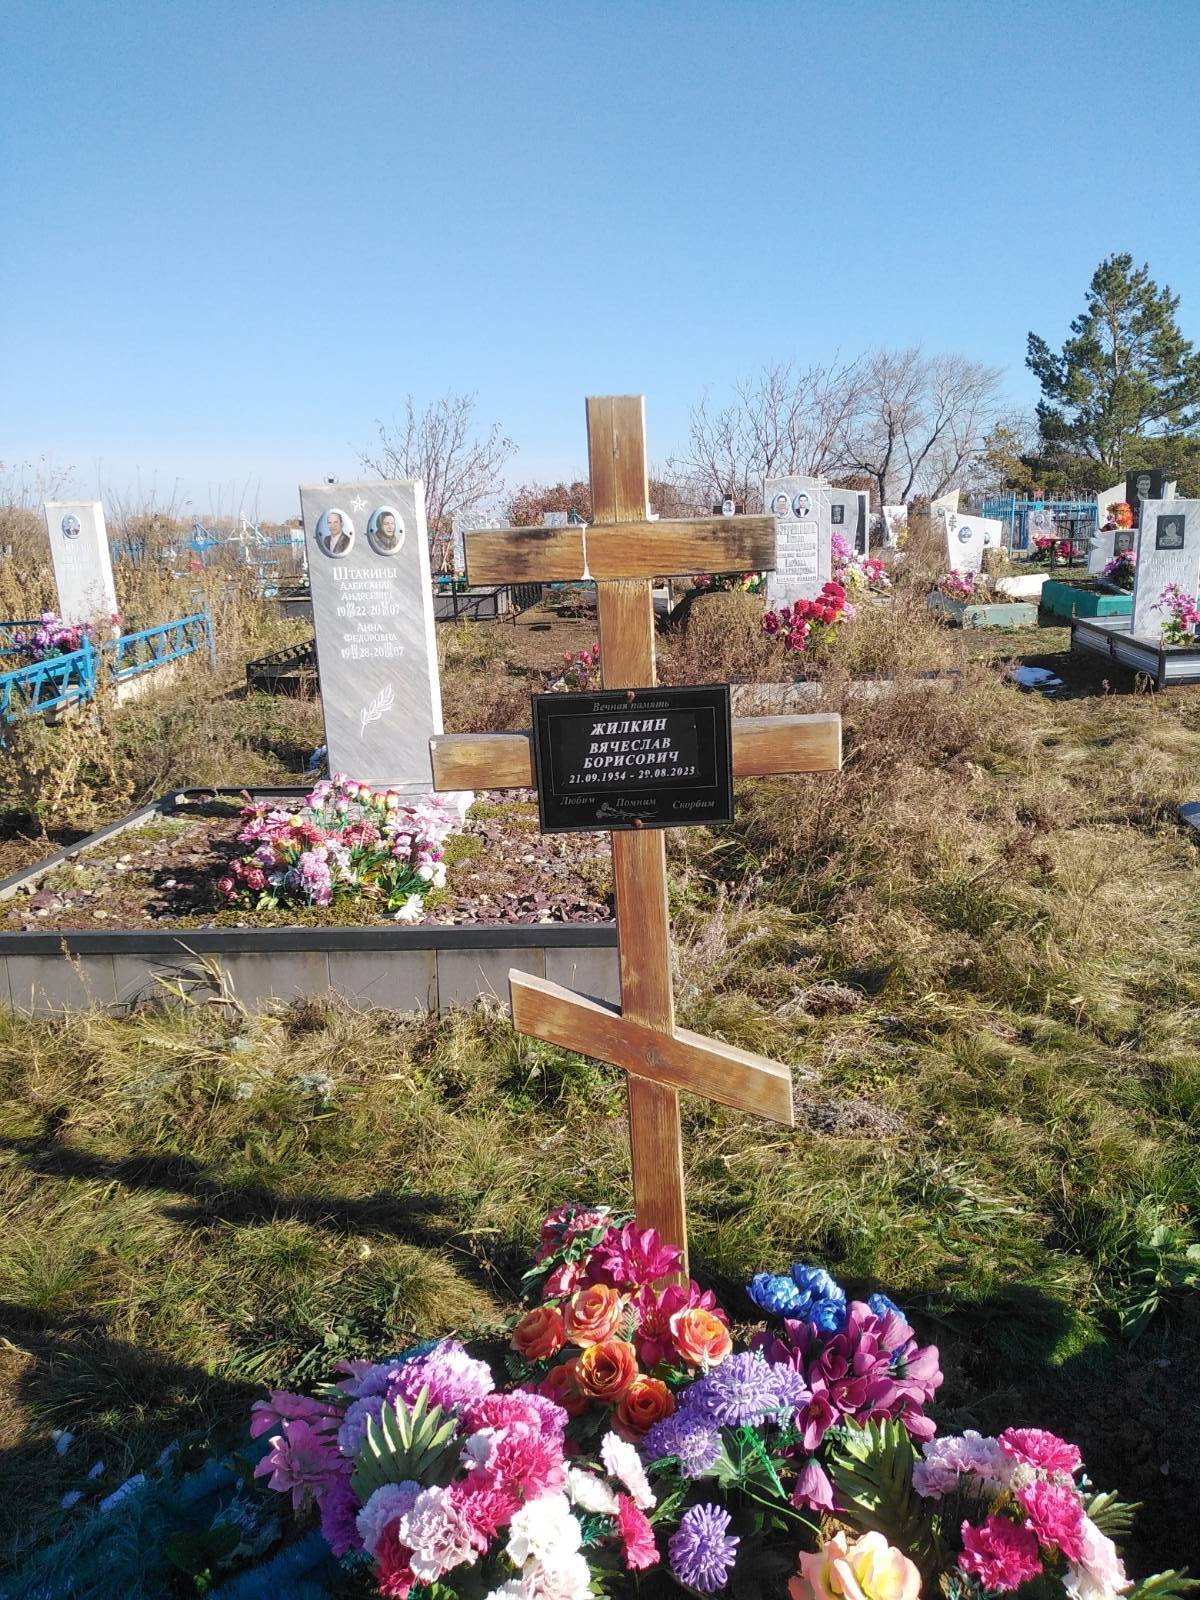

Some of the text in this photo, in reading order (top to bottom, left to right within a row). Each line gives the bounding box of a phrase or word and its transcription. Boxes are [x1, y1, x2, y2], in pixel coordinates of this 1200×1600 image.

[593, 701, 670, 712] Вечная память
[590, 718, 668, 736] ЖИЛКИН
[589, 737, 671, 754] ВЯЧЕСЛАВ
[583, 751, 679, 769] БОРИСОВИЧ
[569, 771, 626, 784] 21.09.1954
[639, 766, 695, 779] 29.08.2023
[560, 796, 716, 810] Любим Помним Скорбим
